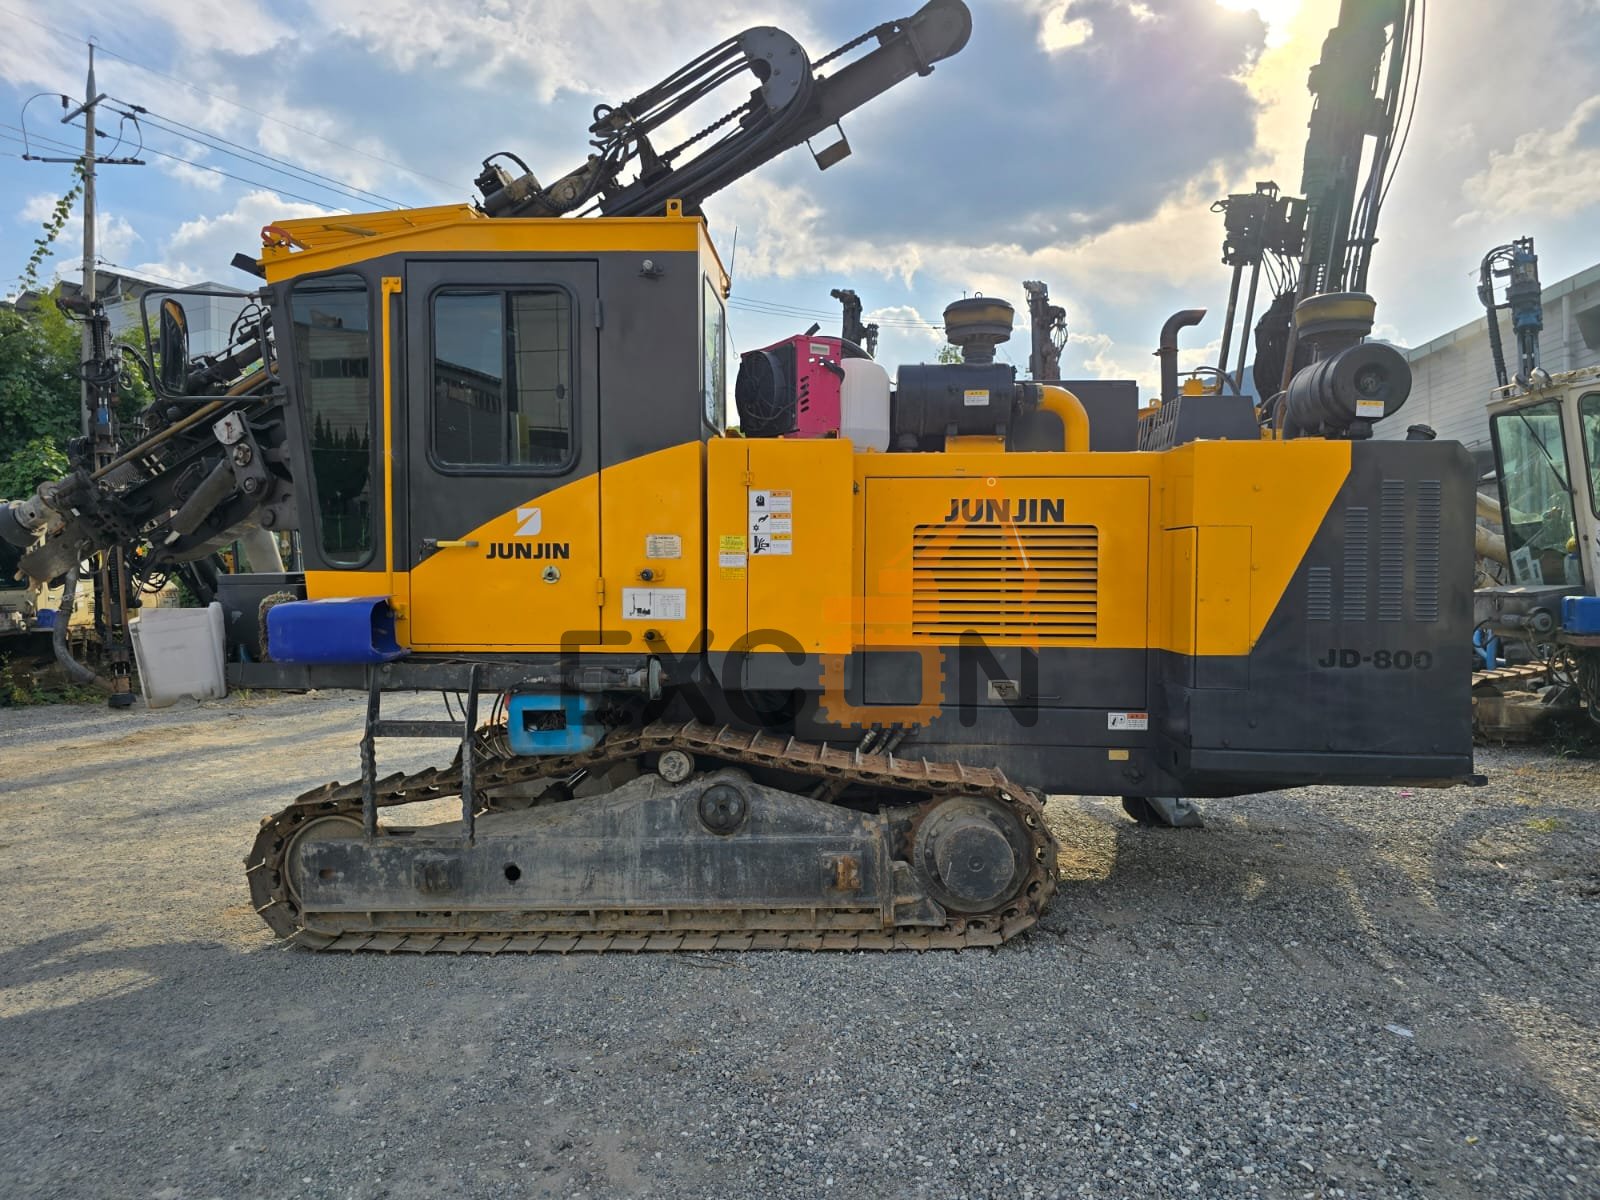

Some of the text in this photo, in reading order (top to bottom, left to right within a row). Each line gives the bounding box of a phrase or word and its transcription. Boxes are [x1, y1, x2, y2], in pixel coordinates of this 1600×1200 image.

[945, 499, 1065, 523] JUNJIN
[486, 543, 570, 560] JUNJIN
[1318, 648, 1433, 670] JD-800
